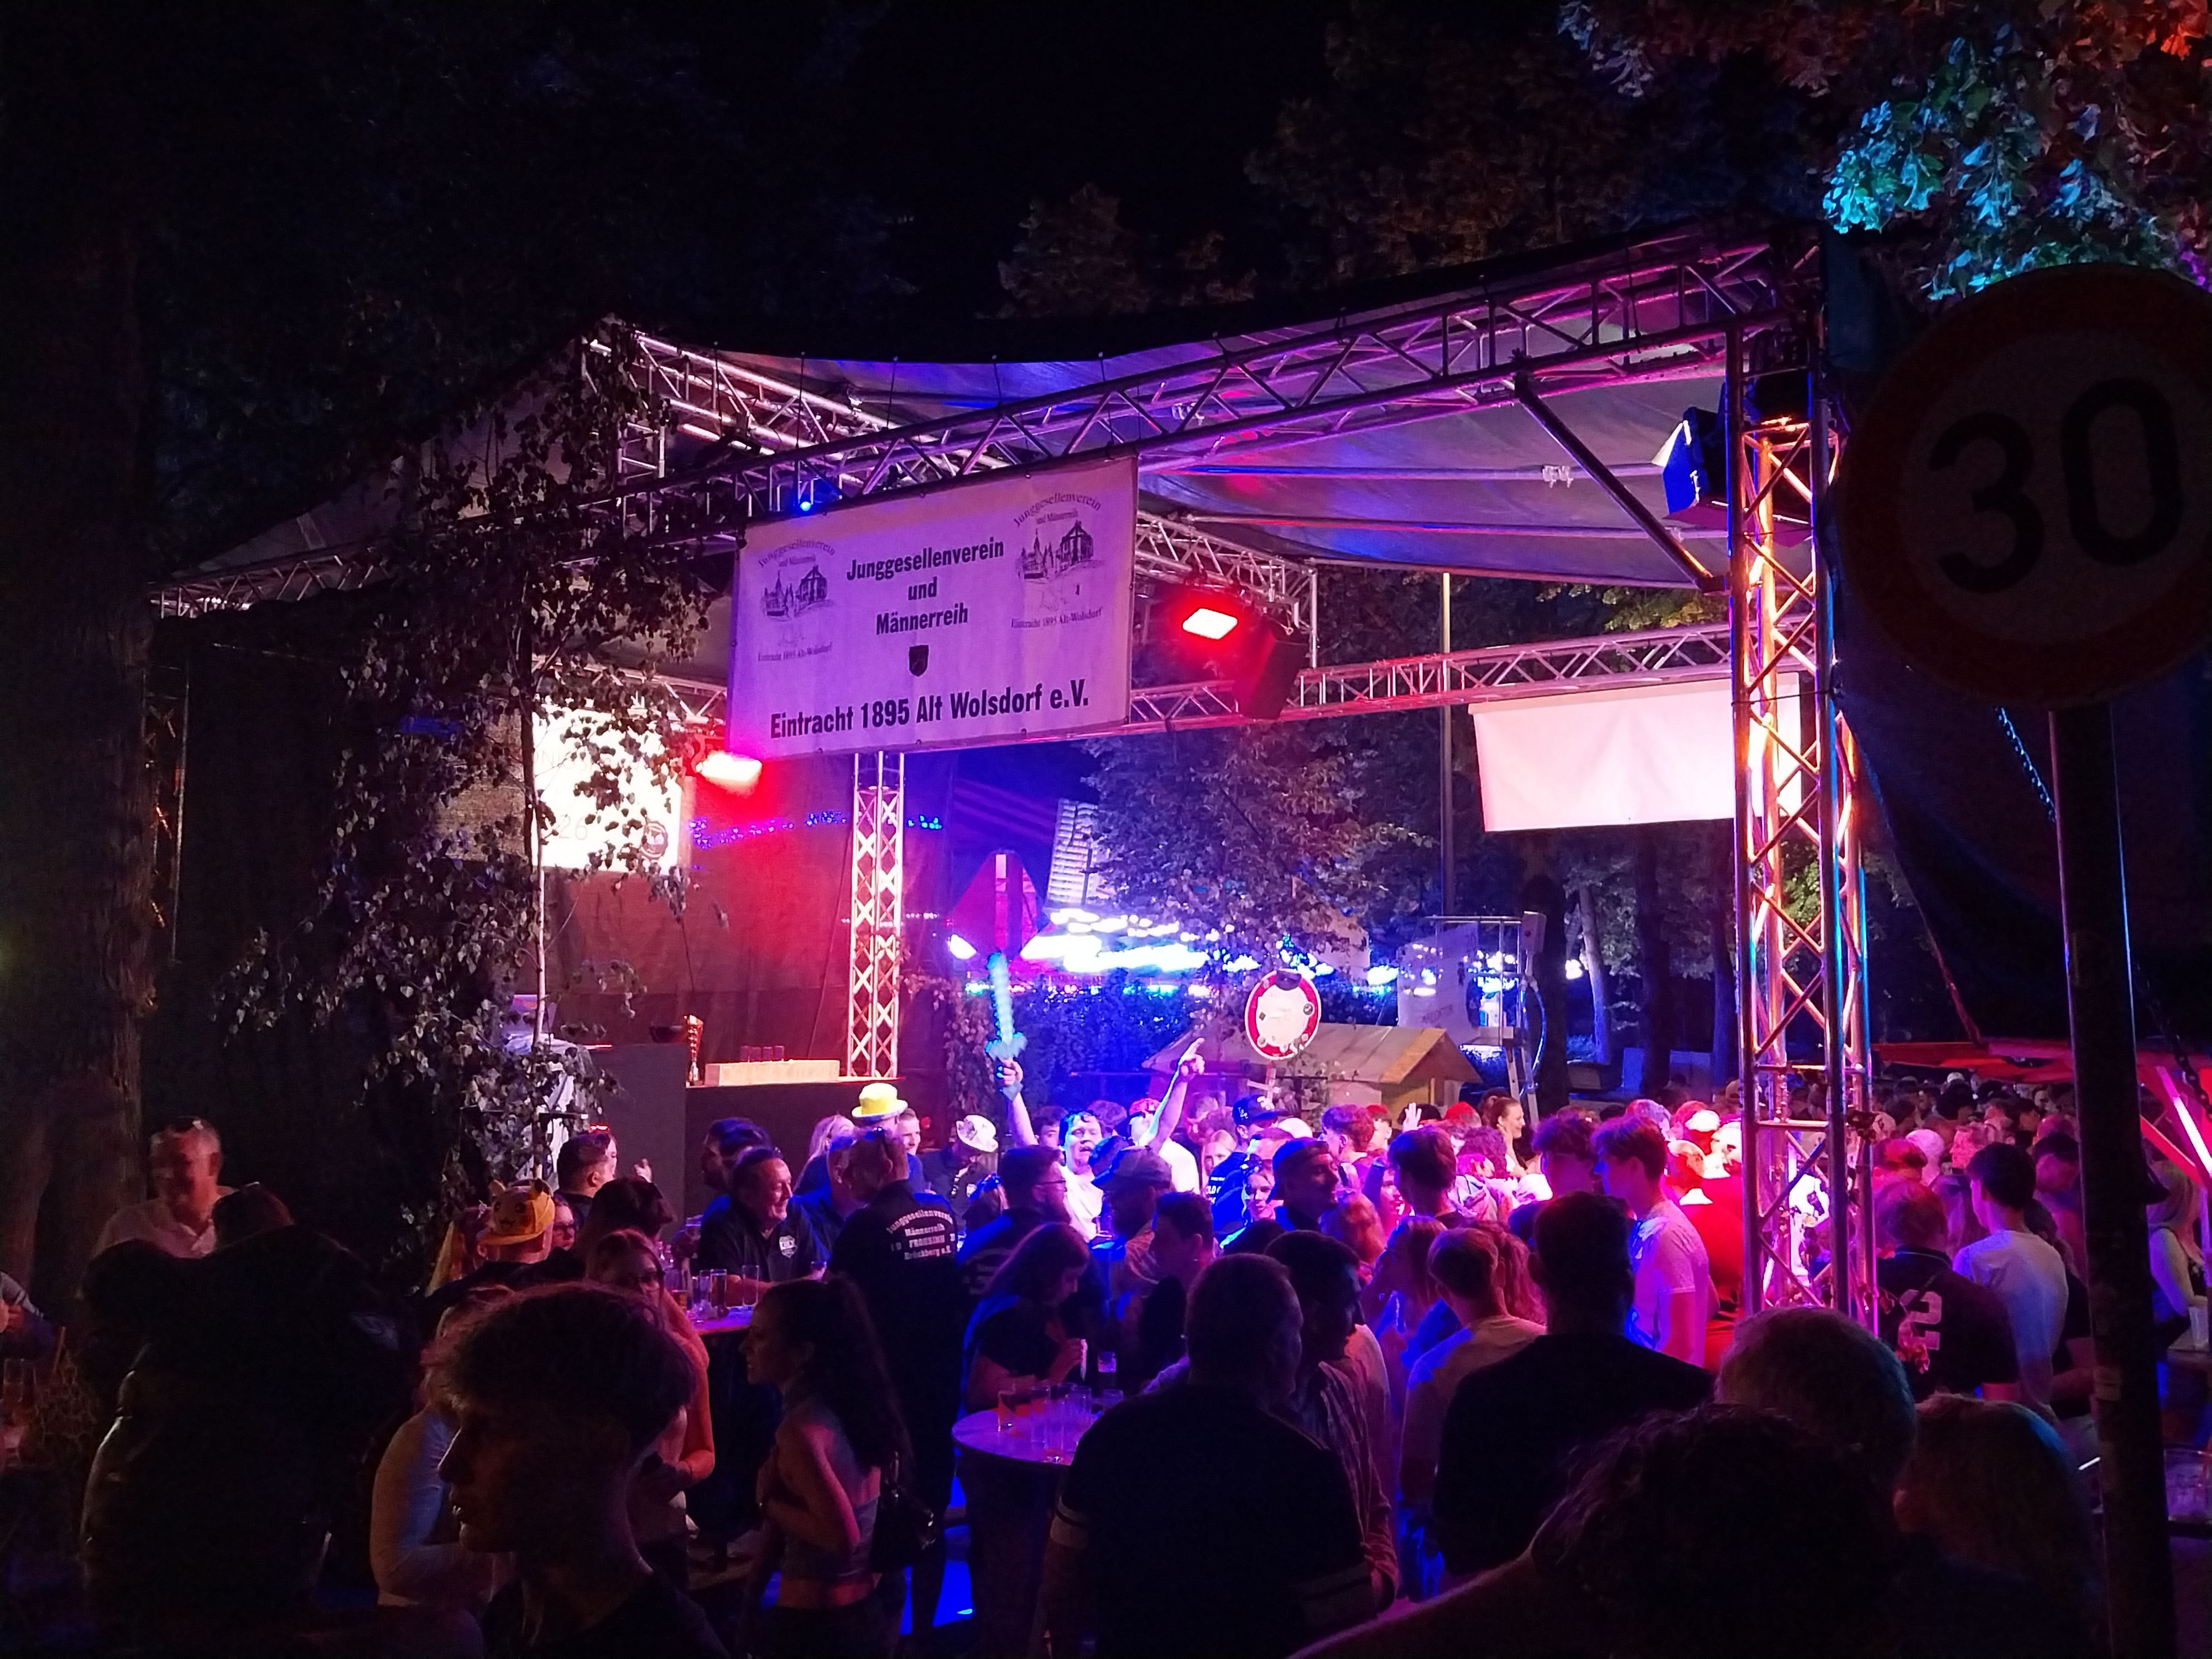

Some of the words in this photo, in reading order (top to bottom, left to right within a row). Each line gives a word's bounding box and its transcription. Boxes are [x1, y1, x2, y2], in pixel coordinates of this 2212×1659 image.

[1929, 378, 2183, 594] 30
[1014, 493, 1101, 527] Junggesellenverein
[758, 539, 835, 568] Junggesellenverein
[847, 537, 1004, 580] Junggesellenverein
[908, 576, 937, 600] und
[877, 602, 968, 634] Männerreih
[770, 705, 853, 739] Eintracht
[860, 698, 910, 728] 1895
[916, 695, 943, 723] Alt
[950, 684, 1042, 719] Wolsdorf
[1051, 679, 1089, 709] e.V.
